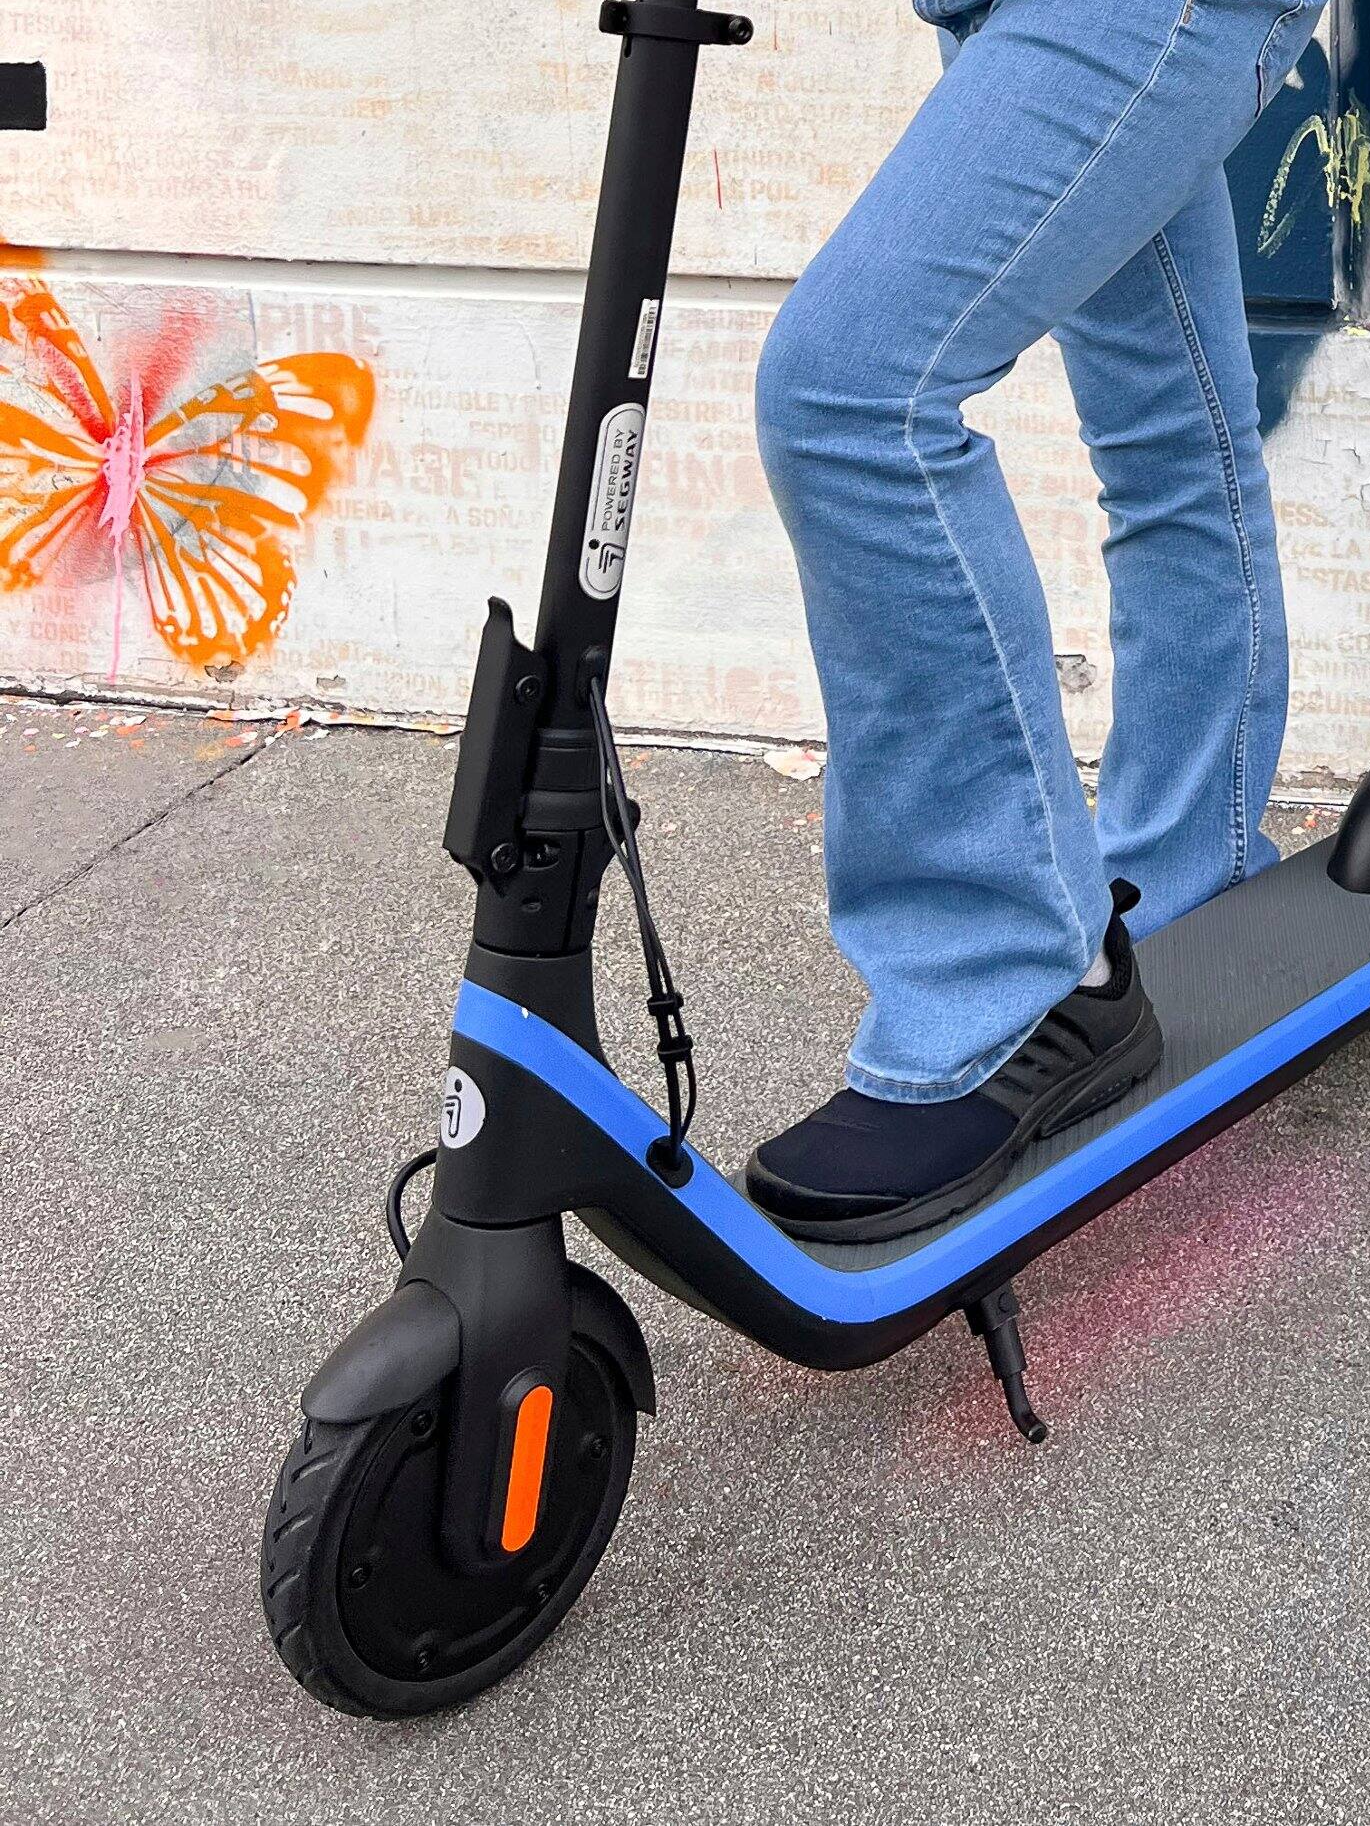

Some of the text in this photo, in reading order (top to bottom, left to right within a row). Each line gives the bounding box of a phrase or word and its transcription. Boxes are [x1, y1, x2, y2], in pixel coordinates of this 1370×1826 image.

[602, 427, 627, 533] POWERED BY
[612, 428, 639, 533] SEGWAY
